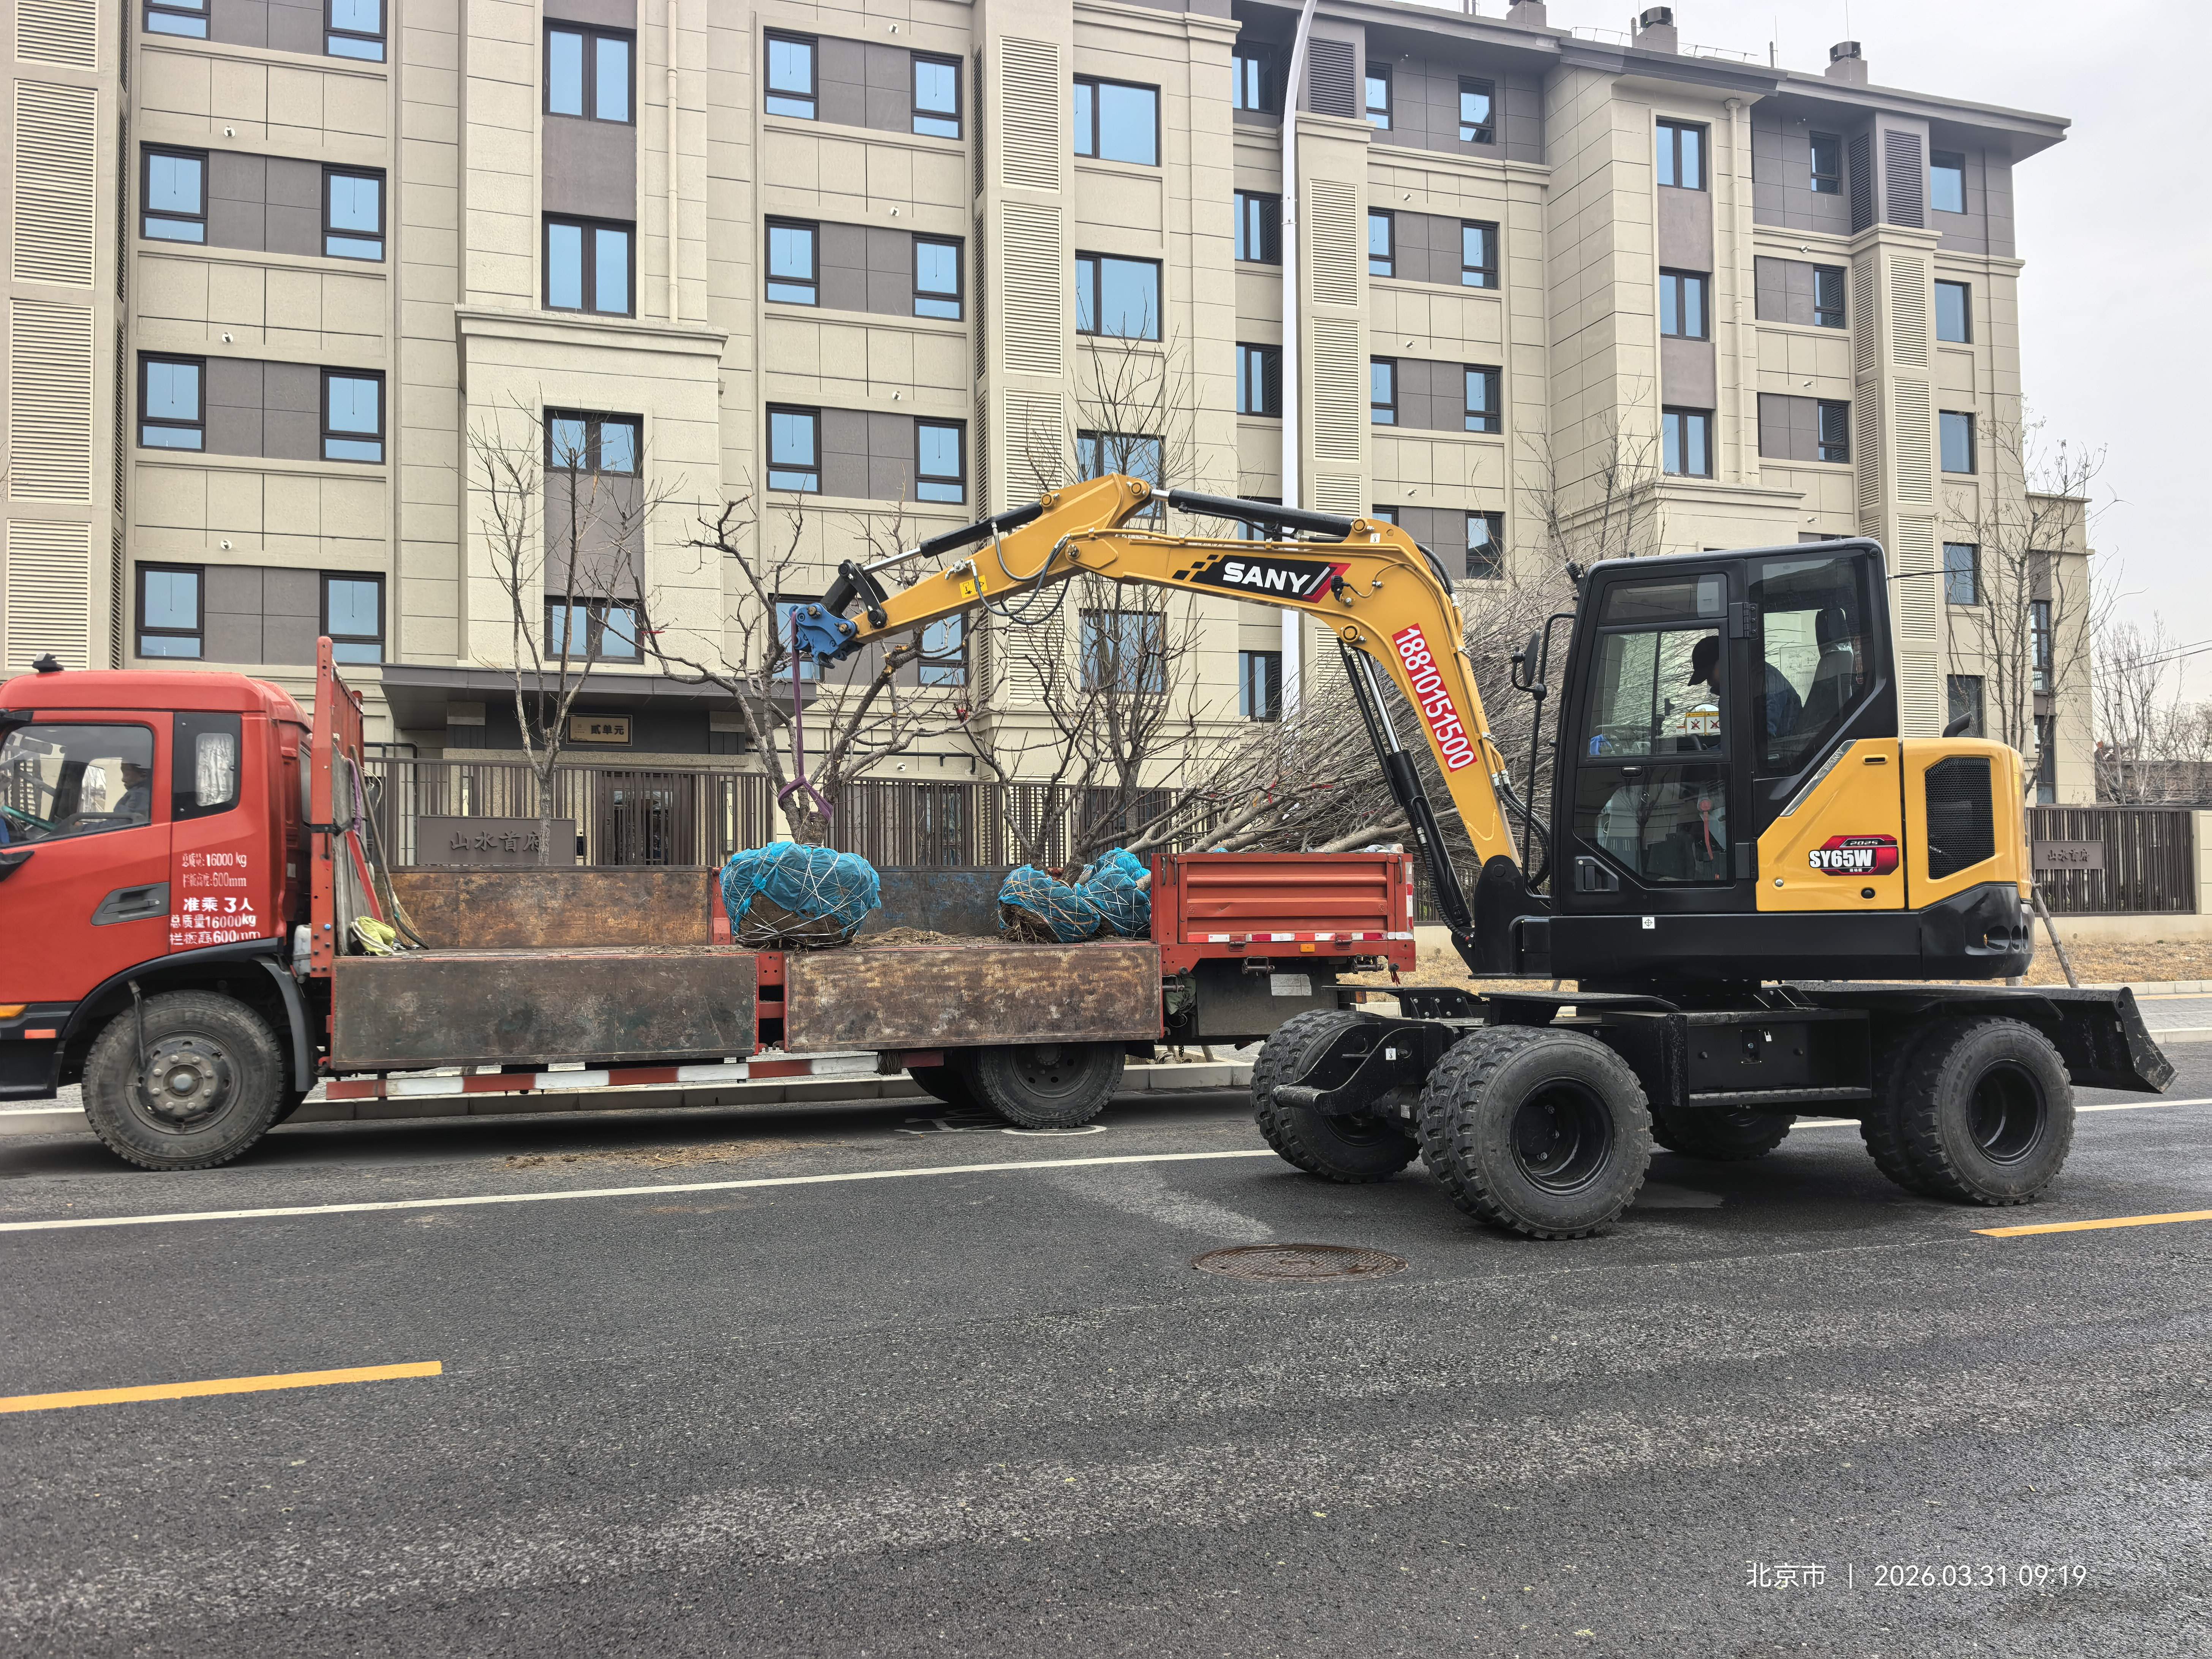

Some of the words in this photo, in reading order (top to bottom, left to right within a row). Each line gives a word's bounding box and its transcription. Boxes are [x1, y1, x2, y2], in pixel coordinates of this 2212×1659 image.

[1223, 562, 1311, 593] SANY
[1396, 628, 1474, 769] 18810151500
[1823, 749, 1844, 771] SANY
[1809, 849, 1872, 868] SY65W
